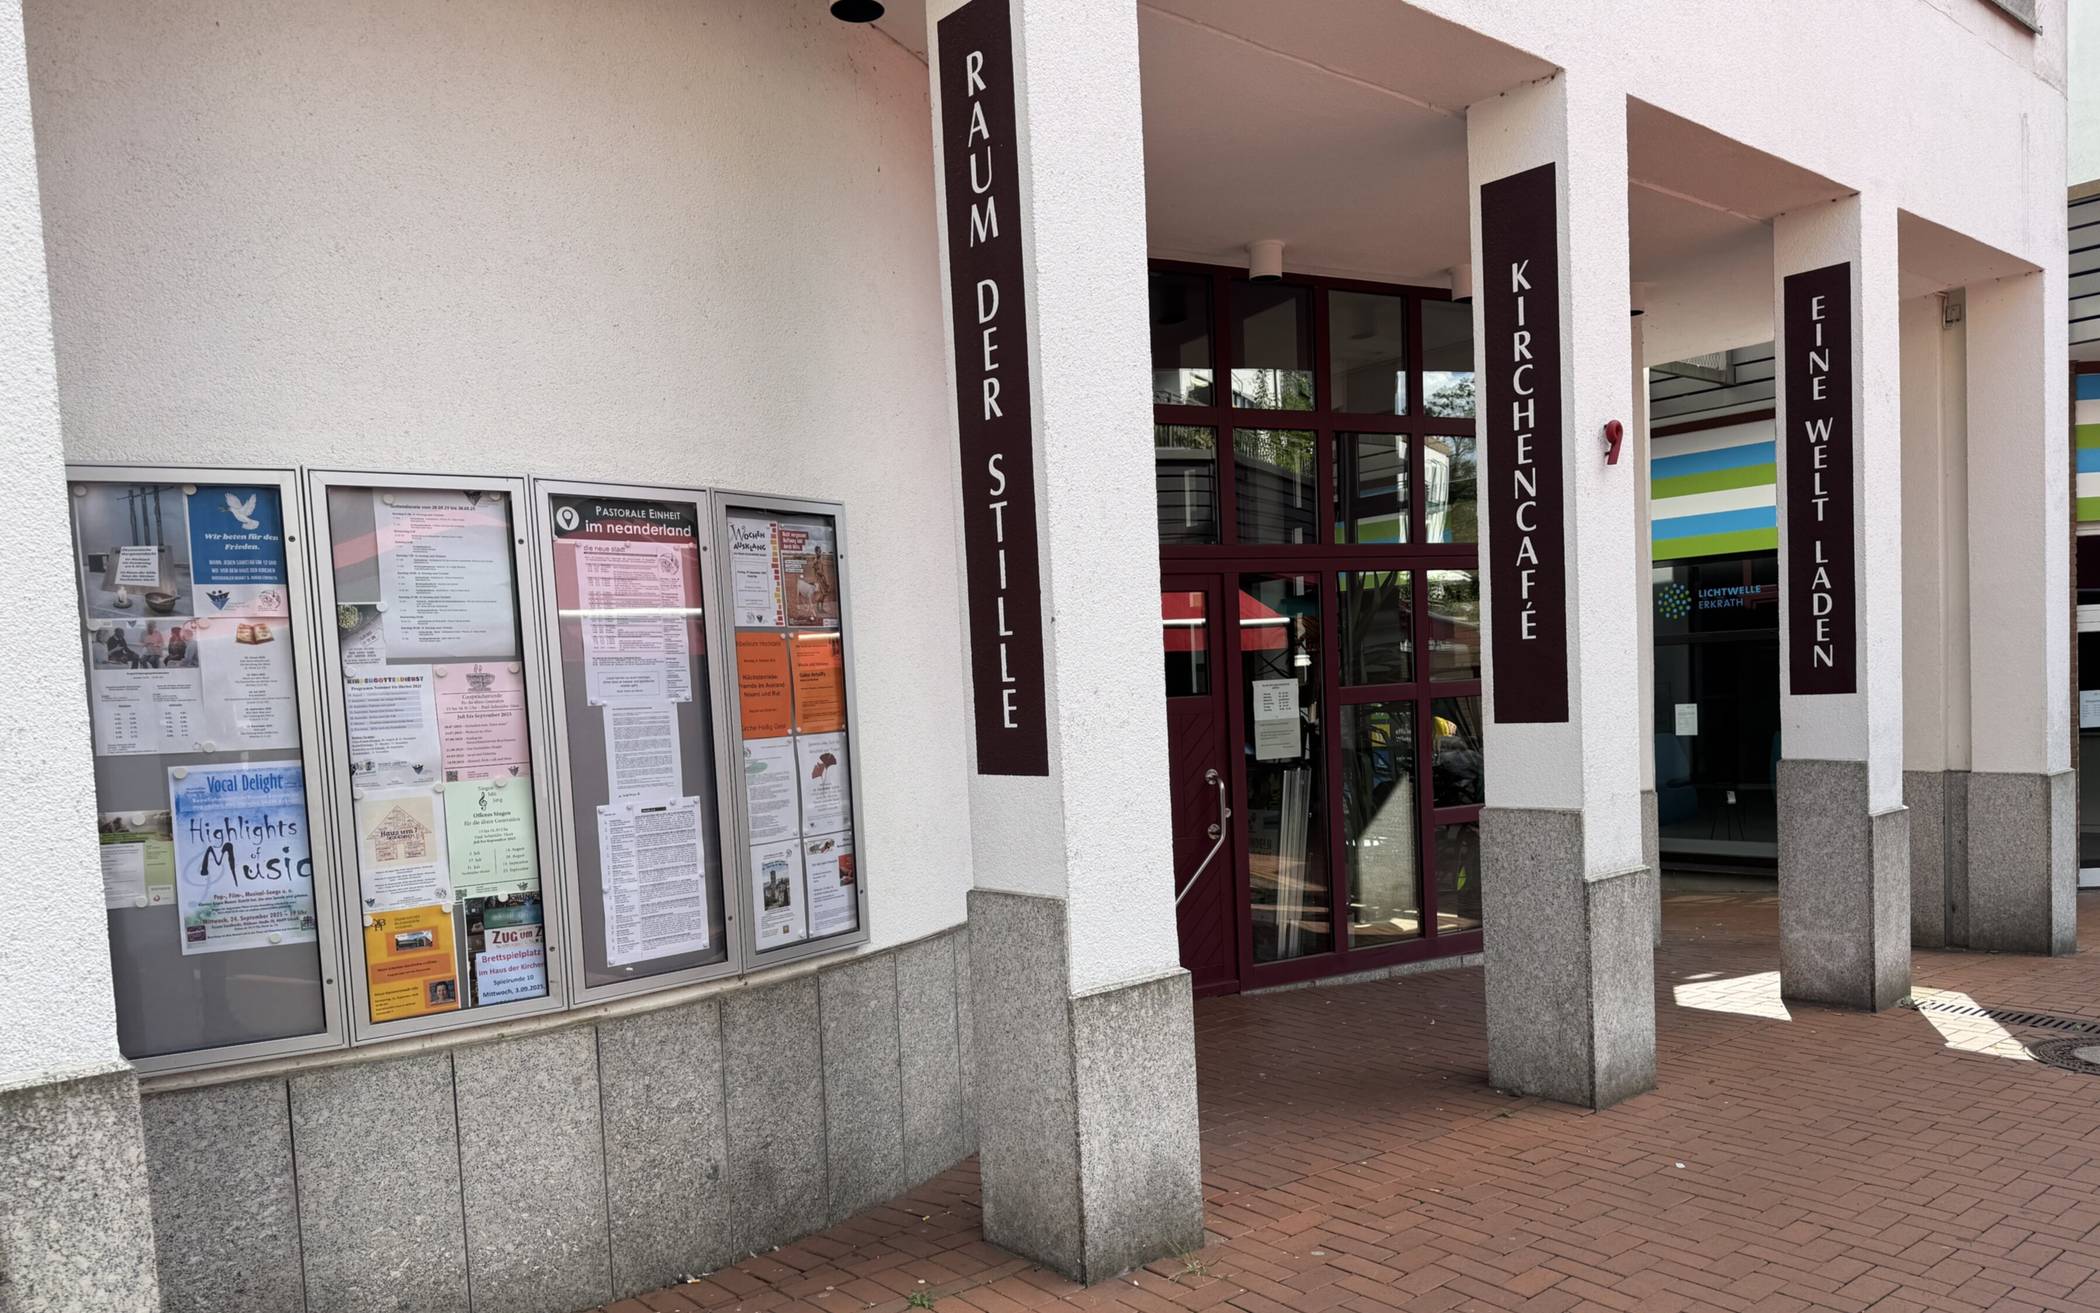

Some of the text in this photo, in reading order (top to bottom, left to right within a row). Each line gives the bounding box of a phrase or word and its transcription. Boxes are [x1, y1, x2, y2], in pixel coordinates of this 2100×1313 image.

[966, 50, 1018, 729] RAUM DER STILLE
[1511, 259, 1539, 640] KIRCHENCAFÉ
[1805, 295, 1834, 669] EINE WELT LADEN
[585, 519, 692, 537] im neanderland
[204, 532, 279, 541] Wir beten für den
[224, 543, 261, 551] Frieden.
[1698, 584, 1762, 598] LICHTWELLE
[1698, 597, 1744, 610] ERKRATH
[206, 775, 239, 793] Vocal
[241, 773, 284, 794] Delight
[190, 814, 298, 850] Highlights
[251, 846, 262, 859] of
[201, 842, 313, 887] Music
[491, 930, 518, 945] ZUG
[481, 949, 542, 964] Brettspielplatz
[489, 967, 507, 976] Haus
[507, 964, 520, 973] der
[493, 975, 526, 986] Spielrunde
